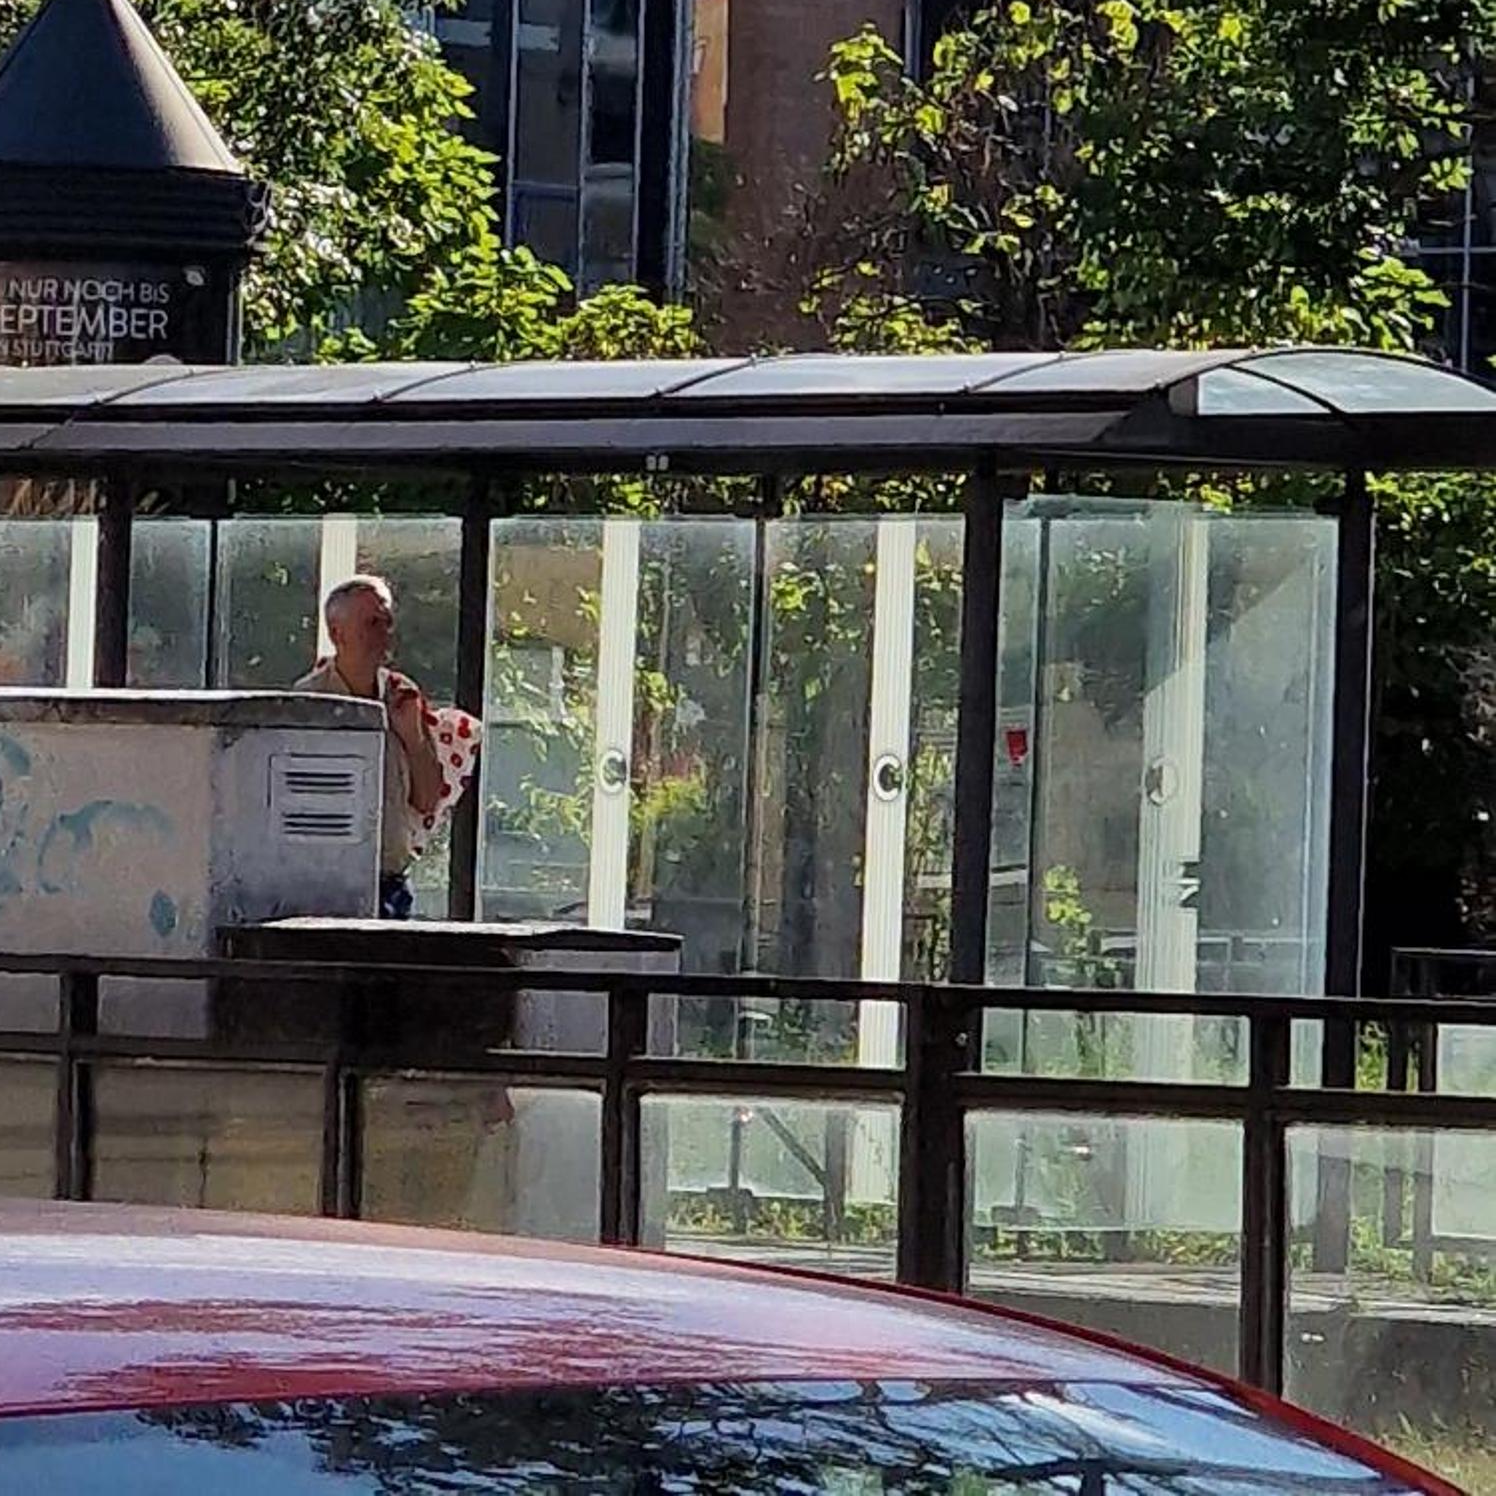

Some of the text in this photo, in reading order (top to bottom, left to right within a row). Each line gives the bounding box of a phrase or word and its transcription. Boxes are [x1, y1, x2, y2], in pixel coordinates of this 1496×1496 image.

[7, 278, 170, 303] NUR NOCH BIS
[11, 338, 114, 361] STUTTGART
